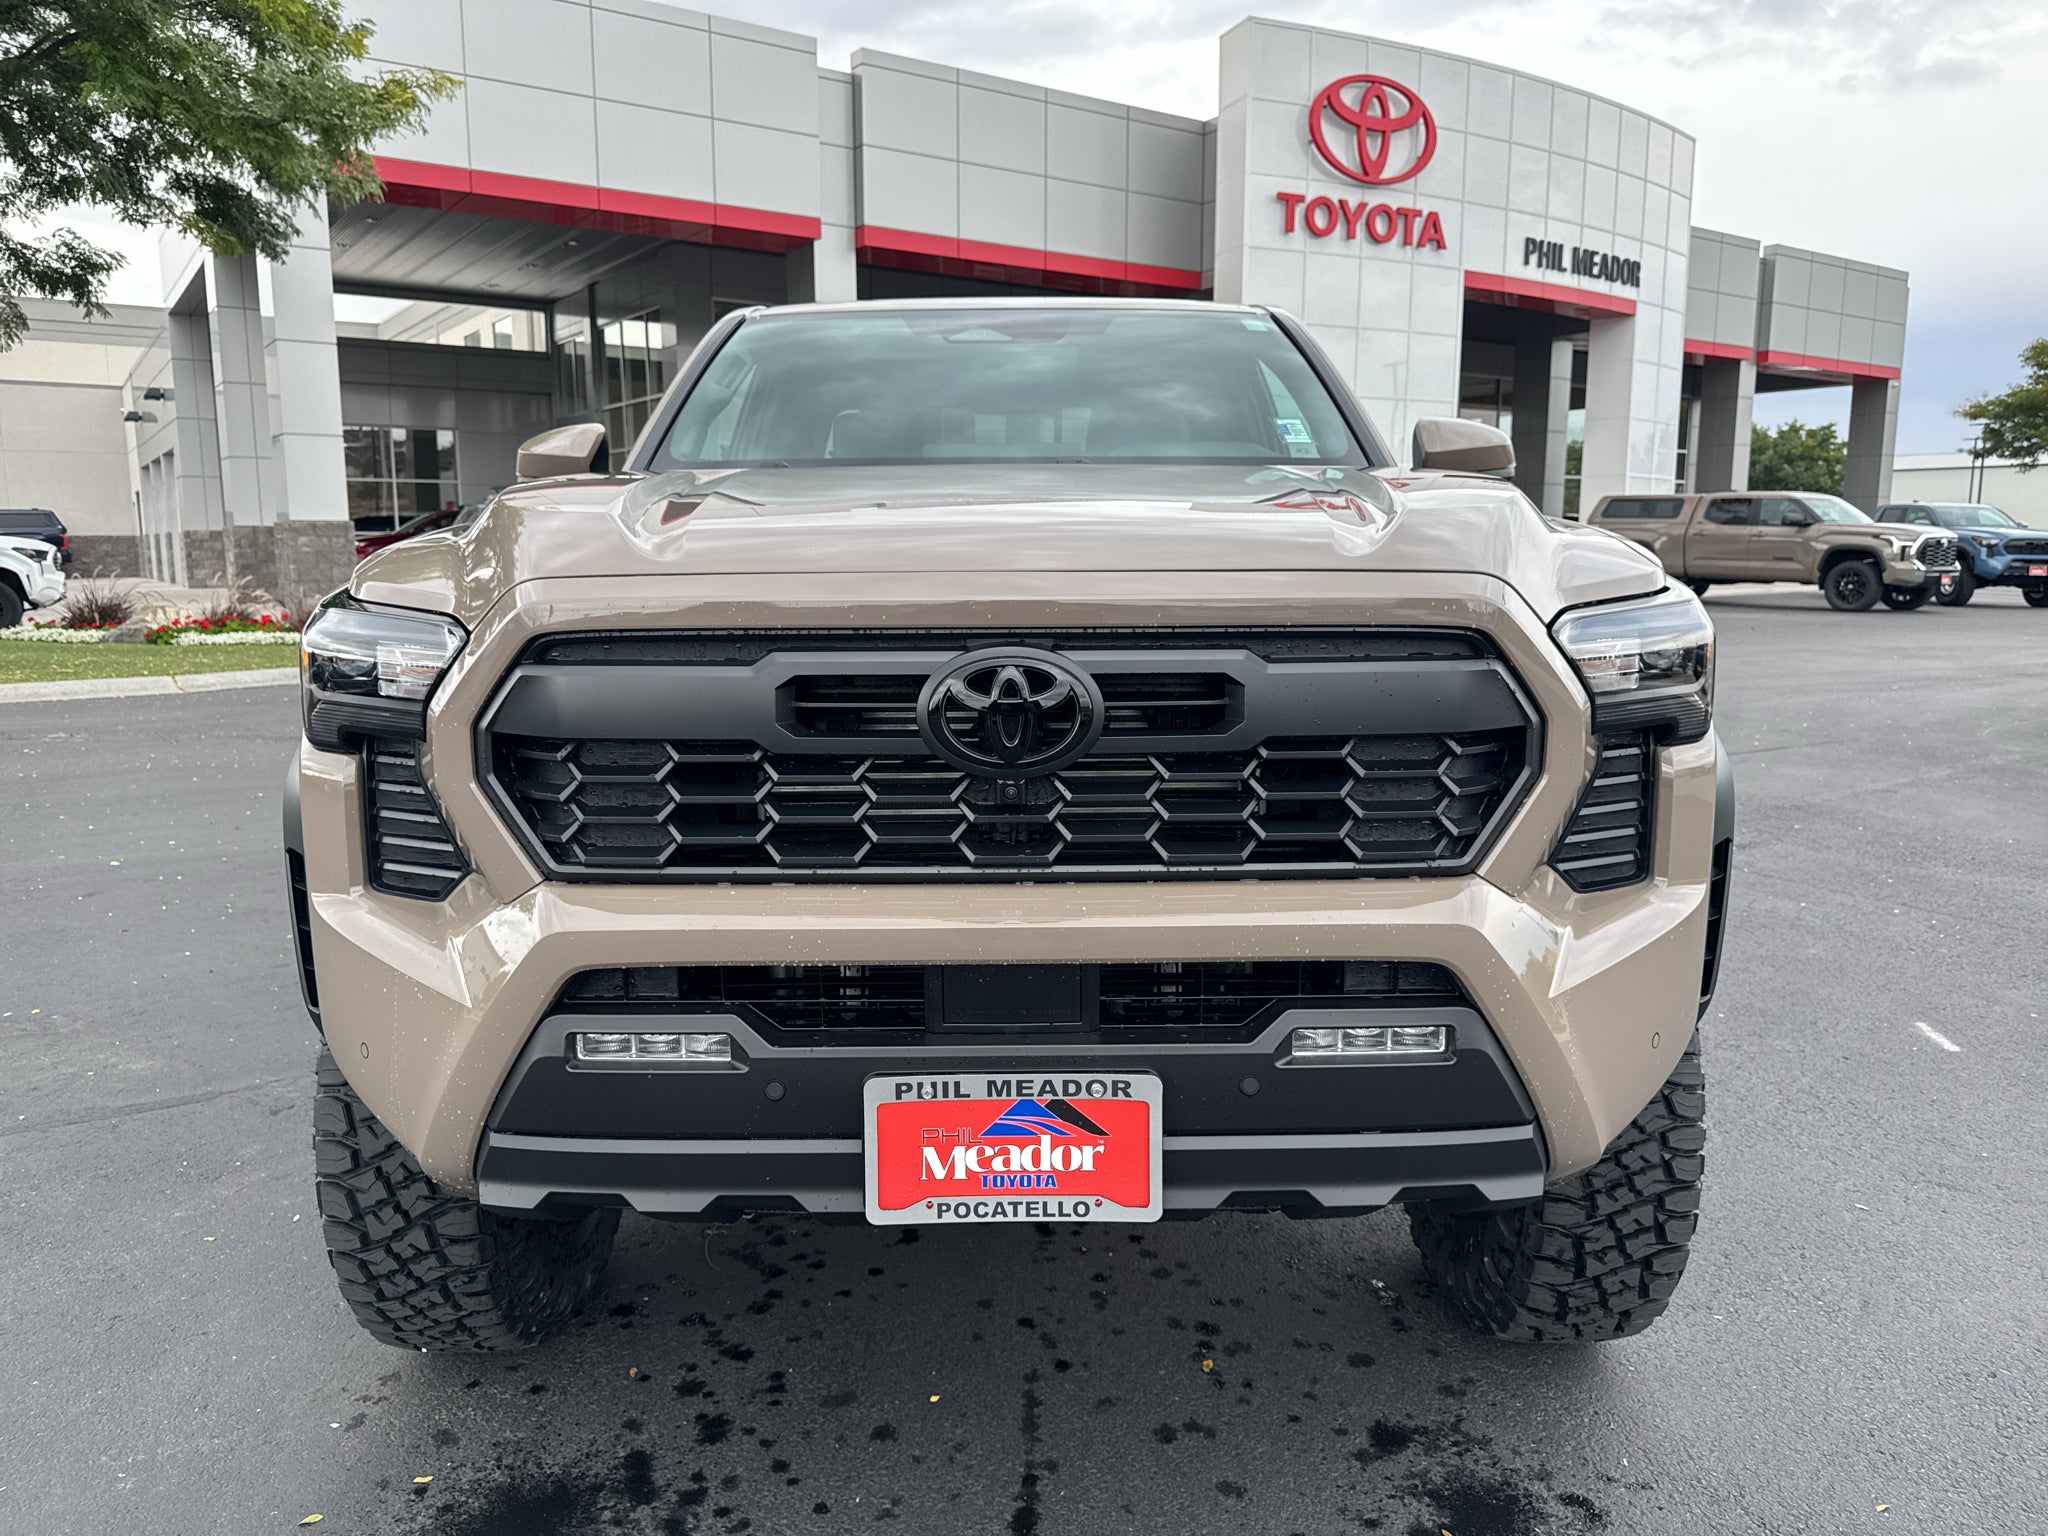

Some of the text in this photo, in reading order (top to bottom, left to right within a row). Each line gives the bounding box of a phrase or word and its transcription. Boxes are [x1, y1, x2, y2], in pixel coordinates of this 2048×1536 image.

[1276, 192, 1447, 250] TOYOTA
[1523, 236, 1641, 288] PHIL MEADOR
[895, 1079, 1132, 1100] PHIL MEADOR
[921, 1127, 983, 1145] PHIL
[919, 1134, 1105, 1181] Meador
[979, 1174, 1058, 1189] TOYOTA
[936, 1201, 1090, 1219] POCATELLO
